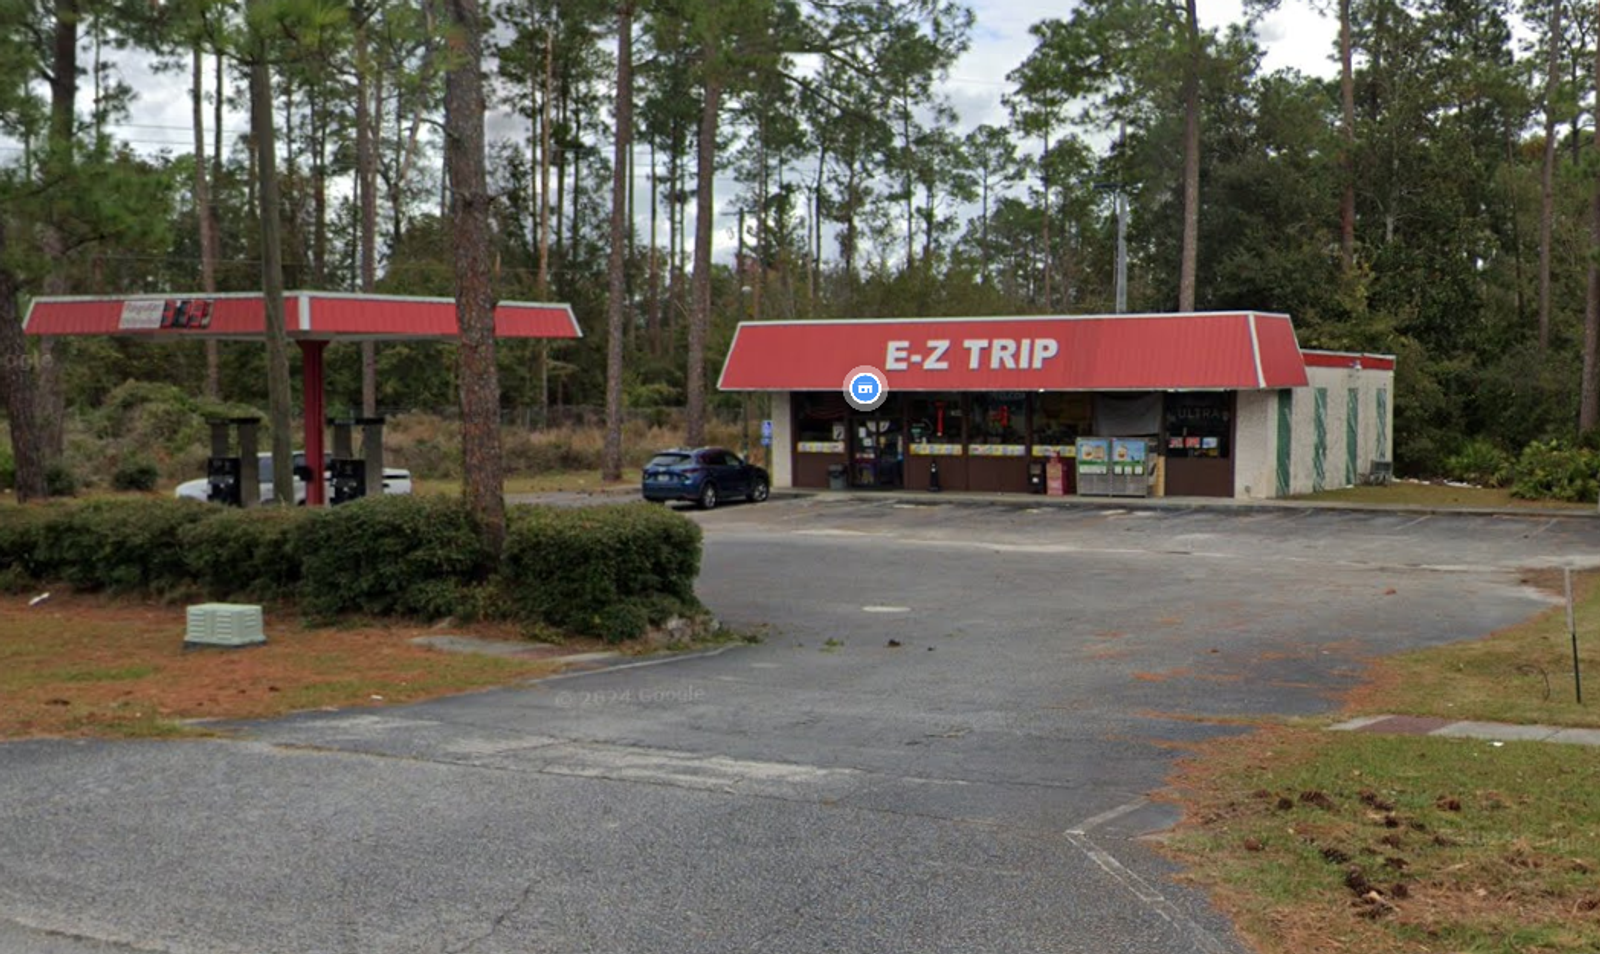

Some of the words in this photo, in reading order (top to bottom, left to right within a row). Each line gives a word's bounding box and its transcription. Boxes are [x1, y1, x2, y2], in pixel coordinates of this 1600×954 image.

[885, 339, 951, 371] E-Z
[963, 337, 1059, 370] TRIP
[1178, 407, 1220, 418] ULTRA
